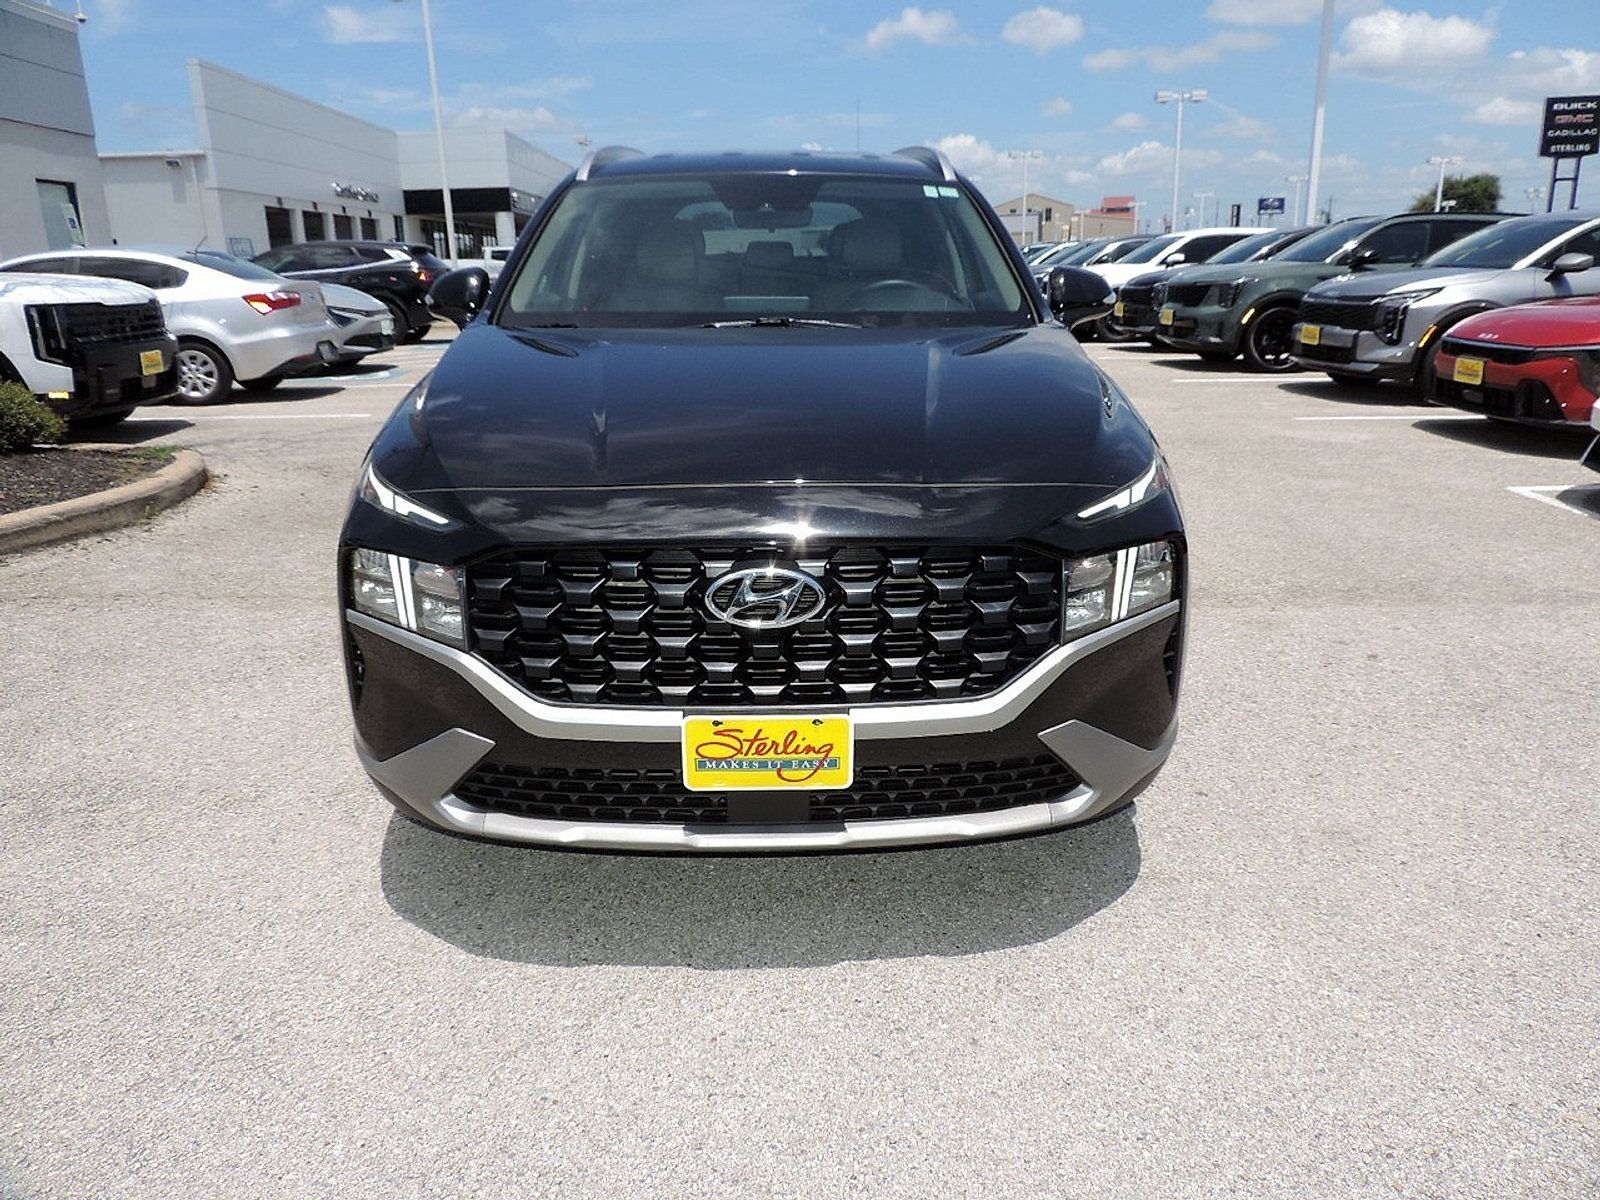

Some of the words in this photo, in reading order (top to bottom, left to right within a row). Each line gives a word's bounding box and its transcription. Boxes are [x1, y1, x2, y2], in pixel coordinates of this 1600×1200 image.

[1553, 102, 1598, 110] BUICK
[1555, 113, 1594, 123] GMC
[1548, 128, 1598, 136] CADILLAC
[1551, 144, 1590, 152] STERLING
[695, 728, 834, 783] Sterling
[704, 759, 760, 769] MAKES
[767, 759, 782, 769] IT
[791, 758, 830, 769] EASY
